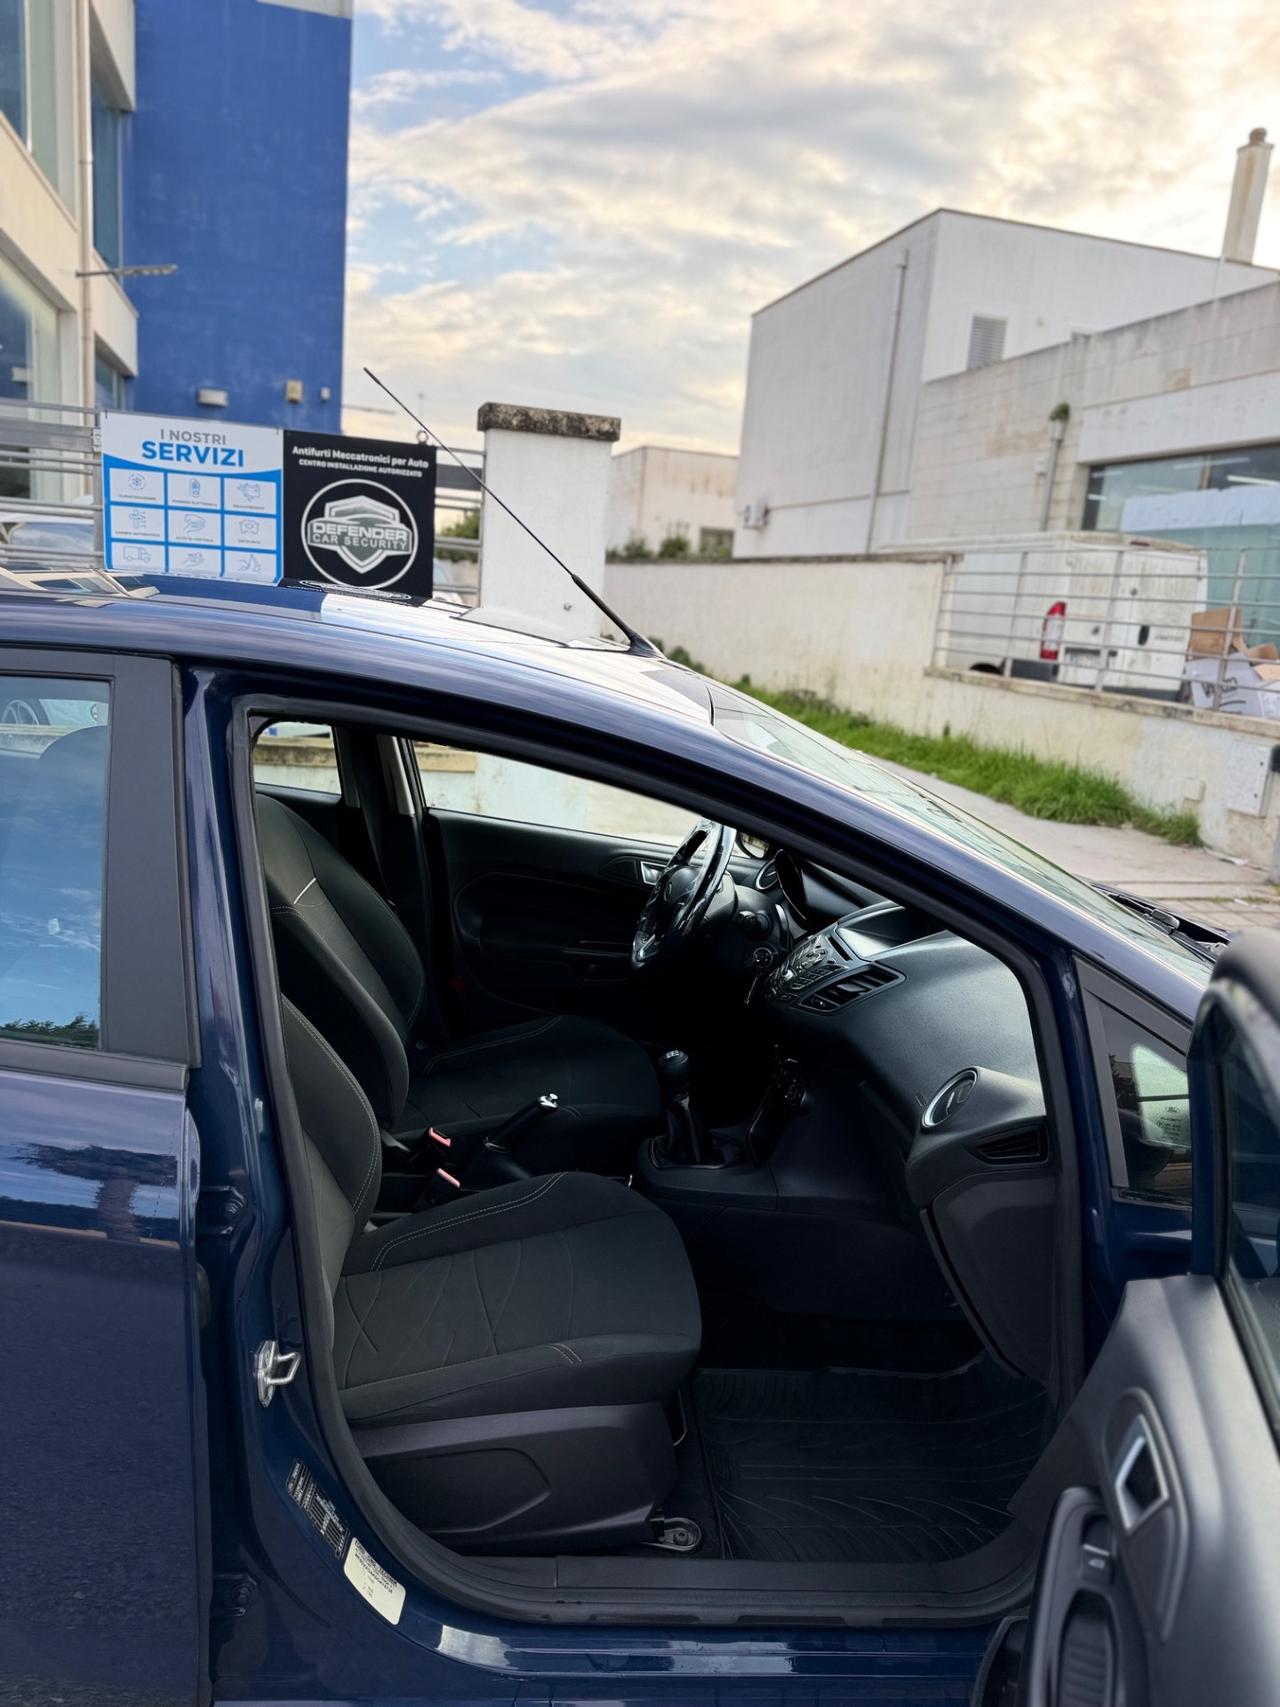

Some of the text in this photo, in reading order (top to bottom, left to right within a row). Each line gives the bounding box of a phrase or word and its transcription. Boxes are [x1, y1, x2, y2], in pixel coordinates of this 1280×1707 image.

[160, 429, 226, 445] I NOSTRI
[142, 440, 244, 467] SERVIZI
[292, 446, 429, 469] Antifurti Meccatronici per Auto
[299, 459, 423, 478] CENTRO INSTALLAZIONE AUTORIZZATO
[313, 522, 407, 541] DEFENDER
[313, 534, 407, 550] CAR SECURITY
